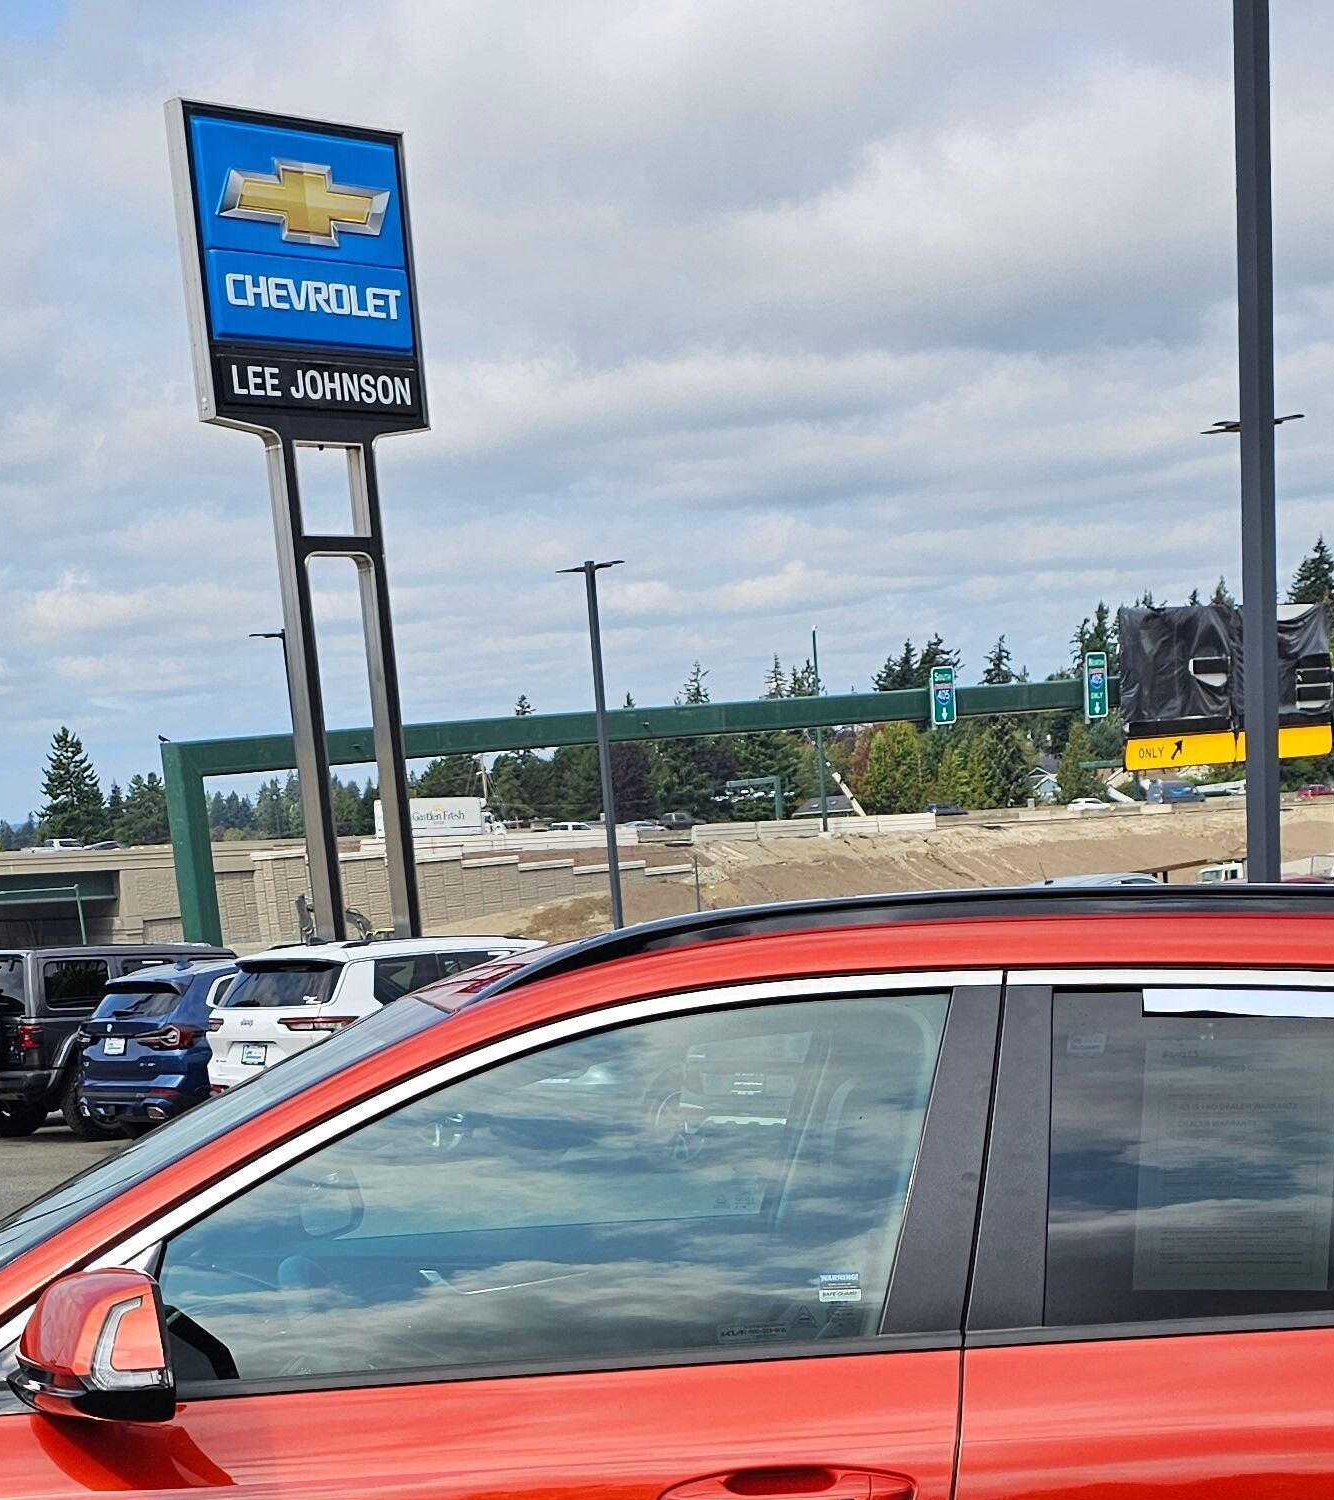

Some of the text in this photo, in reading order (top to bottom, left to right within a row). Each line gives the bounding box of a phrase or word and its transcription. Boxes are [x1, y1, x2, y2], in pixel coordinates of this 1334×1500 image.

[224, 272, 402, 321] CHEVROLET
[230, 364, 413, 406] LEE JOHNSON
[937, 689, 951, 700] 405
[1138, 746, 1165, 760] ONLY
